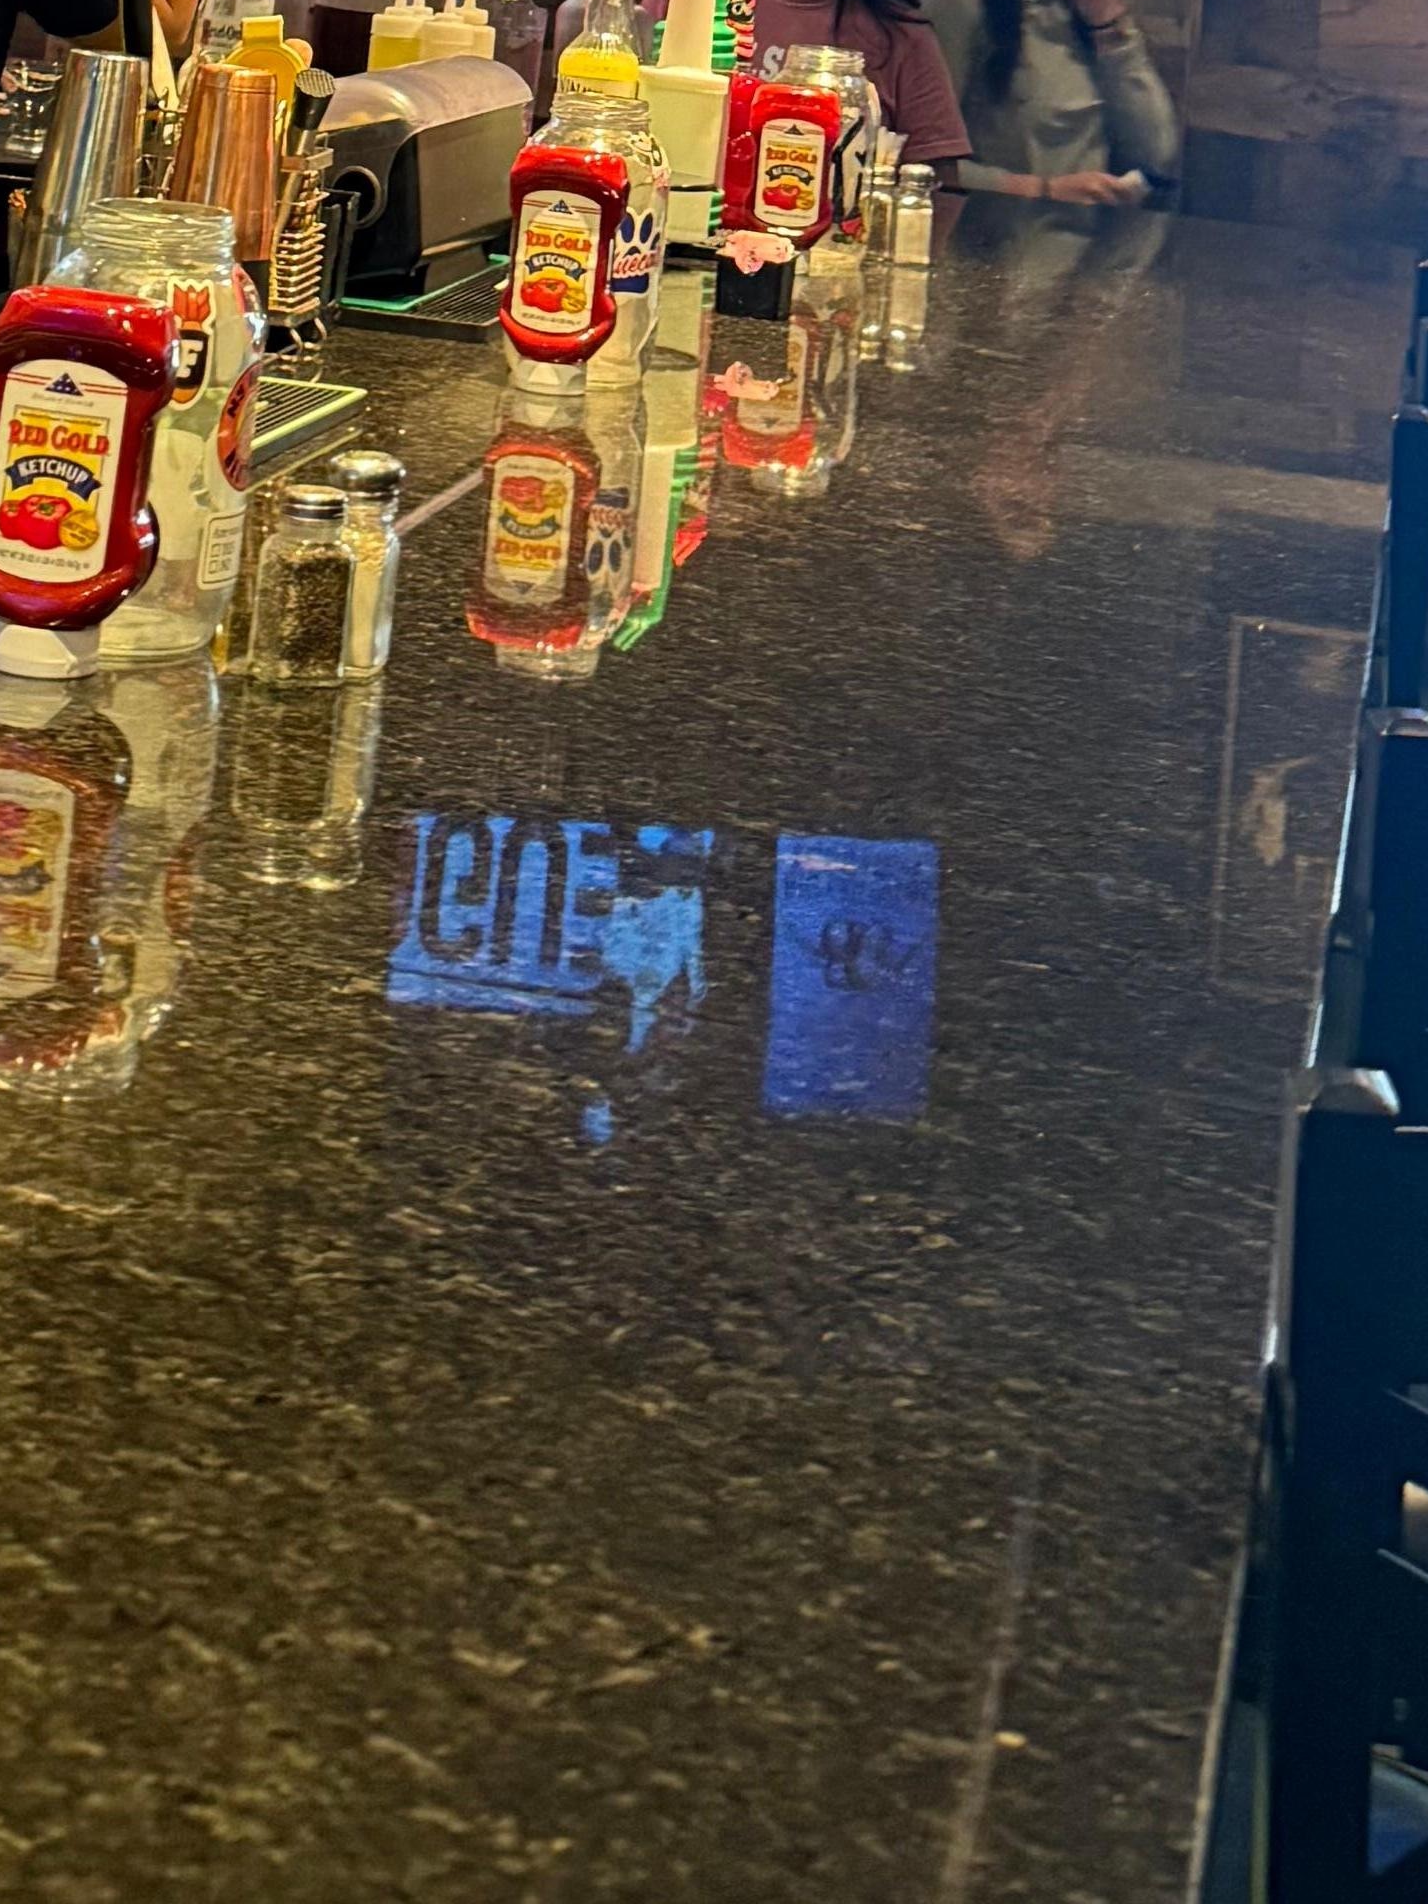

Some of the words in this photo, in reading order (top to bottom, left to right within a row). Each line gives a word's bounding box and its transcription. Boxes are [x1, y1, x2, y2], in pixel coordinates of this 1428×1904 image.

[525, 229, 552, 248] RED
[553, 232, 592, 253] GOLD
[9, 418, 48, 447] RED
[50, 423, 111, 457] GOLD
[18, 454, 88, 486] KETCHUP
